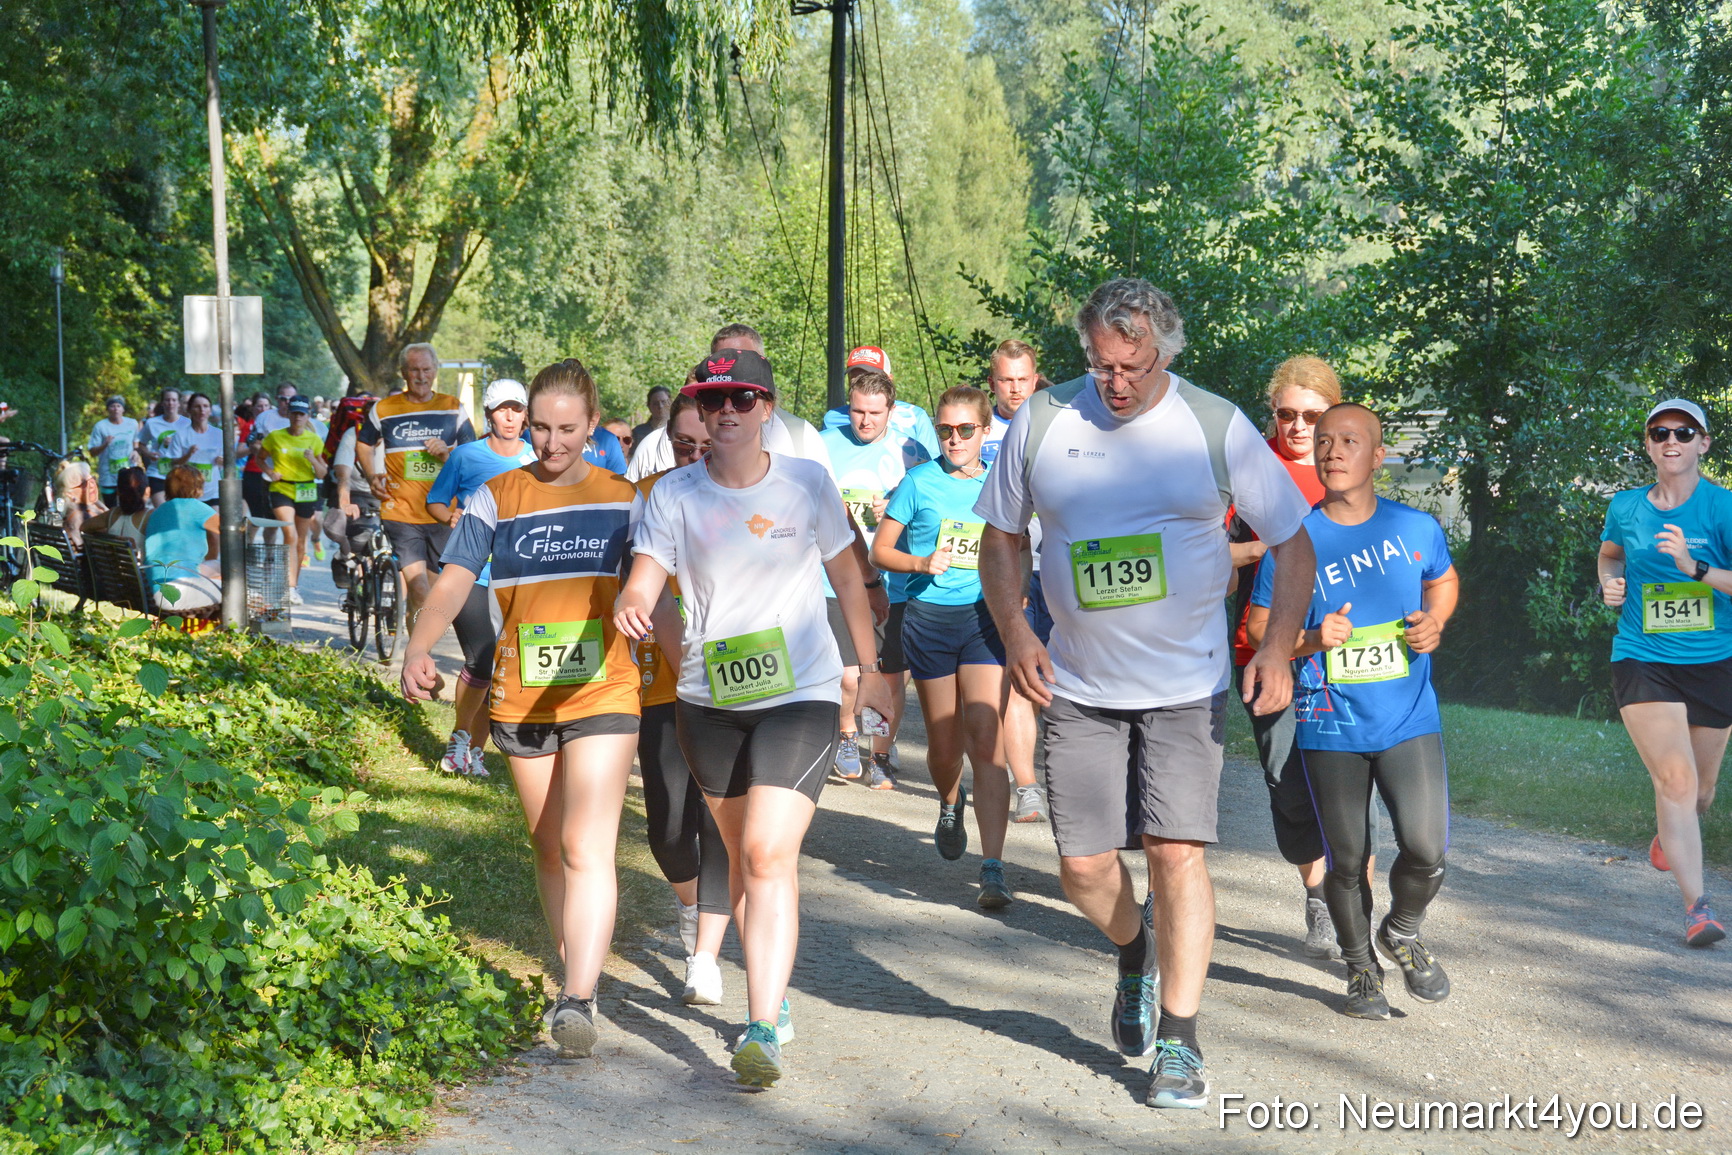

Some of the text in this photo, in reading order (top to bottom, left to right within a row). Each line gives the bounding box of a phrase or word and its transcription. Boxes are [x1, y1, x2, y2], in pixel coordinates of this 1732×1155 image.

[706, 374, 732, 382] adidas
[401, 427, 444, 437] Fischer
[413, 462, 436, 473] 595
[532, 535, 609, 554] Fischer
[540, 551, 604, 562] AUTOMOBILE
[1084, 559, 1152, 587] 1139
[1096, 585, 1142, 595] Lerzer Stefan
[1651, 599, 1701, 618] 1541
[538, 643, 585, 668] 574
[1337, 643, 1394, 667] 1731
[717, 653, 779, 686] 1009
[729, 679, 772, 692] Rückert Julia
[745, 687, 767, 695] Neumarkt
